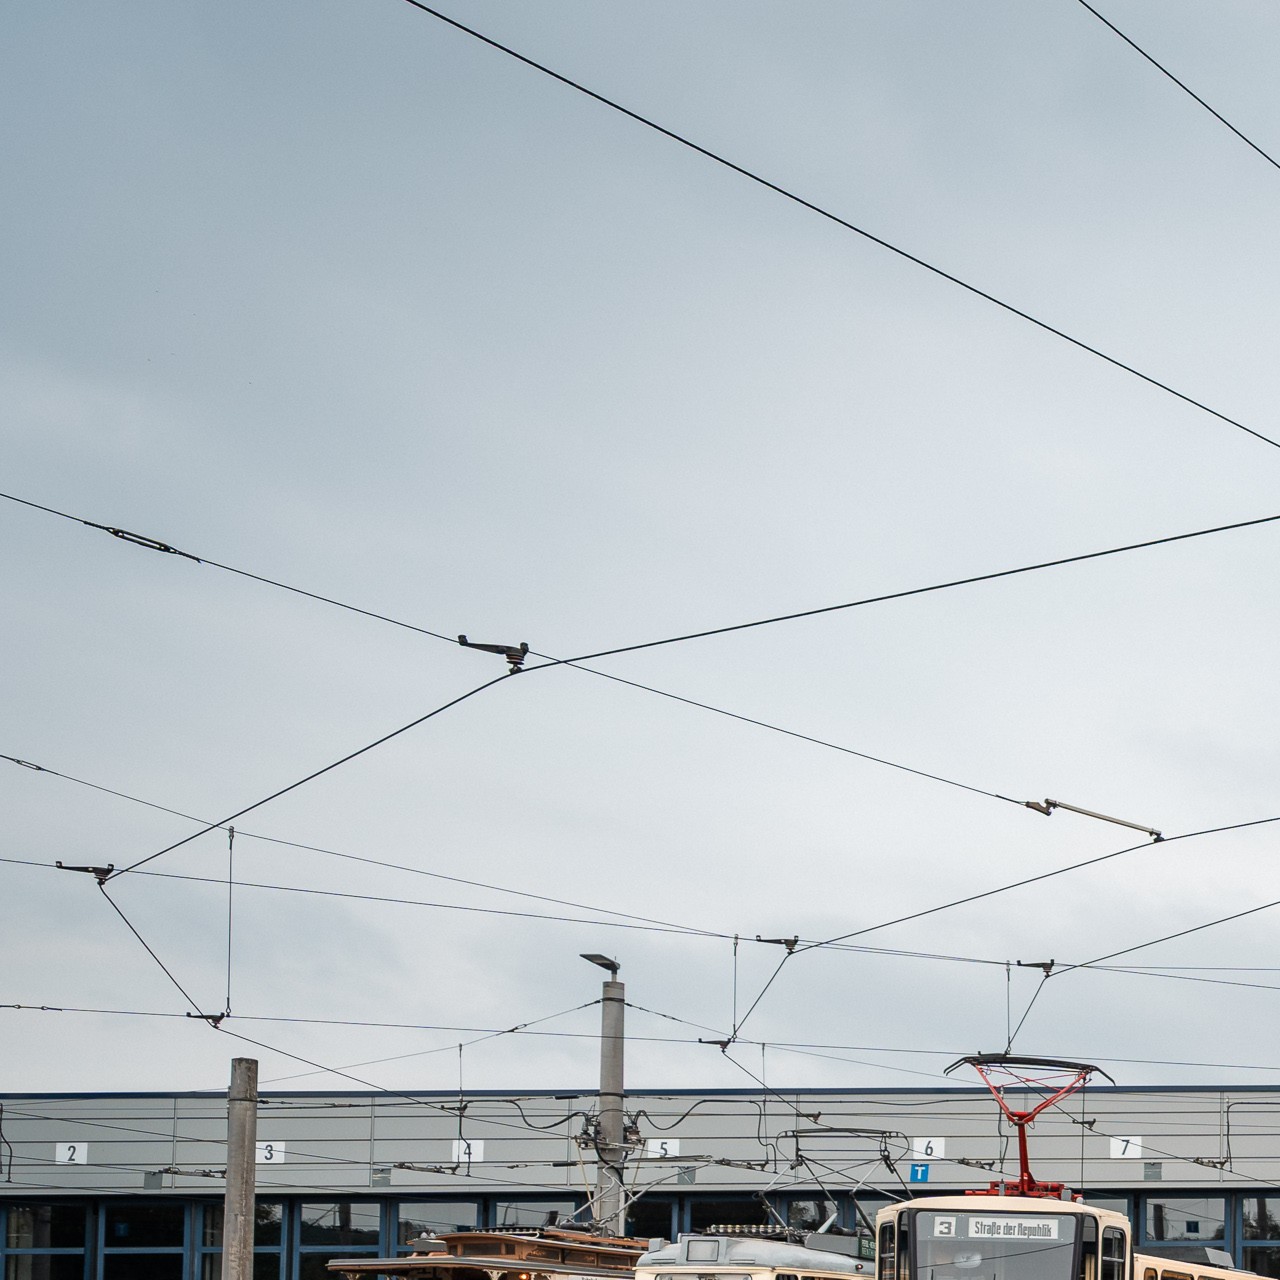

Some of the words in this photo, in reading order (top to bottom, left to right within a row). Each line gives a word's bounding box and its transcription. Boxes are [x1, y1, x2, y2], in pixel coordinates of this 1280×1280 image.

[67, 1145, 76, 1161] 2
[264, 1144, 273, 1160] 3
[463, 1143, 472, 1160] 4
[660, 1142, 667, 1158] 5
[925, 1140, 933, 1156] 6
[1122, 1139, 1130, 1155] 7
[915, 1166, 926, 1179] T
[939, 1221, 952, 1235] 3
[974, 1221, 1001, 1236] Straße
[1002, 1222, 1017, 1236] der
